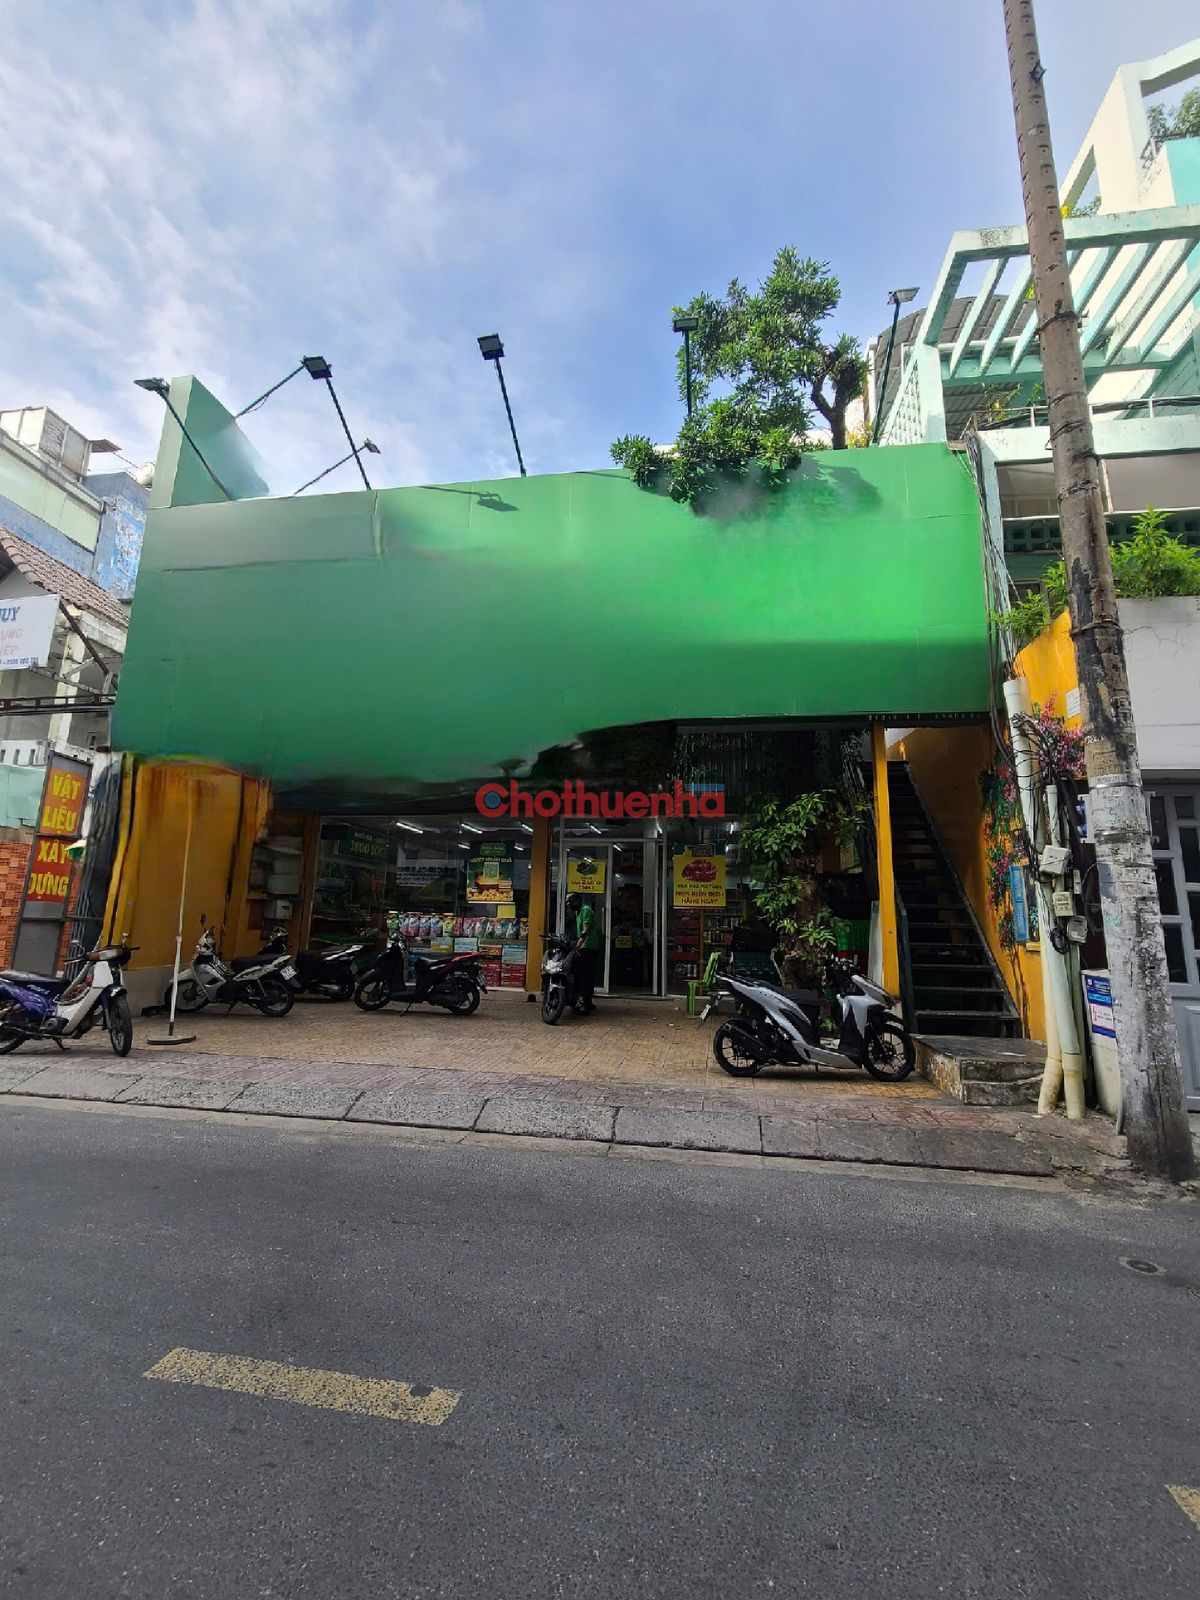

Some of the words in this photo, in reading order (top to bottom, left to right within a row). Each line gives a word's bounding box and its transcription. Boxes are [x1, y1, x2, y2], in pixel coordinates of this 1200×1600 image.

[52, 774, 80, 802] VẬT
[43, 805, 77, 834] LIỆU
[37, 839, 70, 864] XÂY
